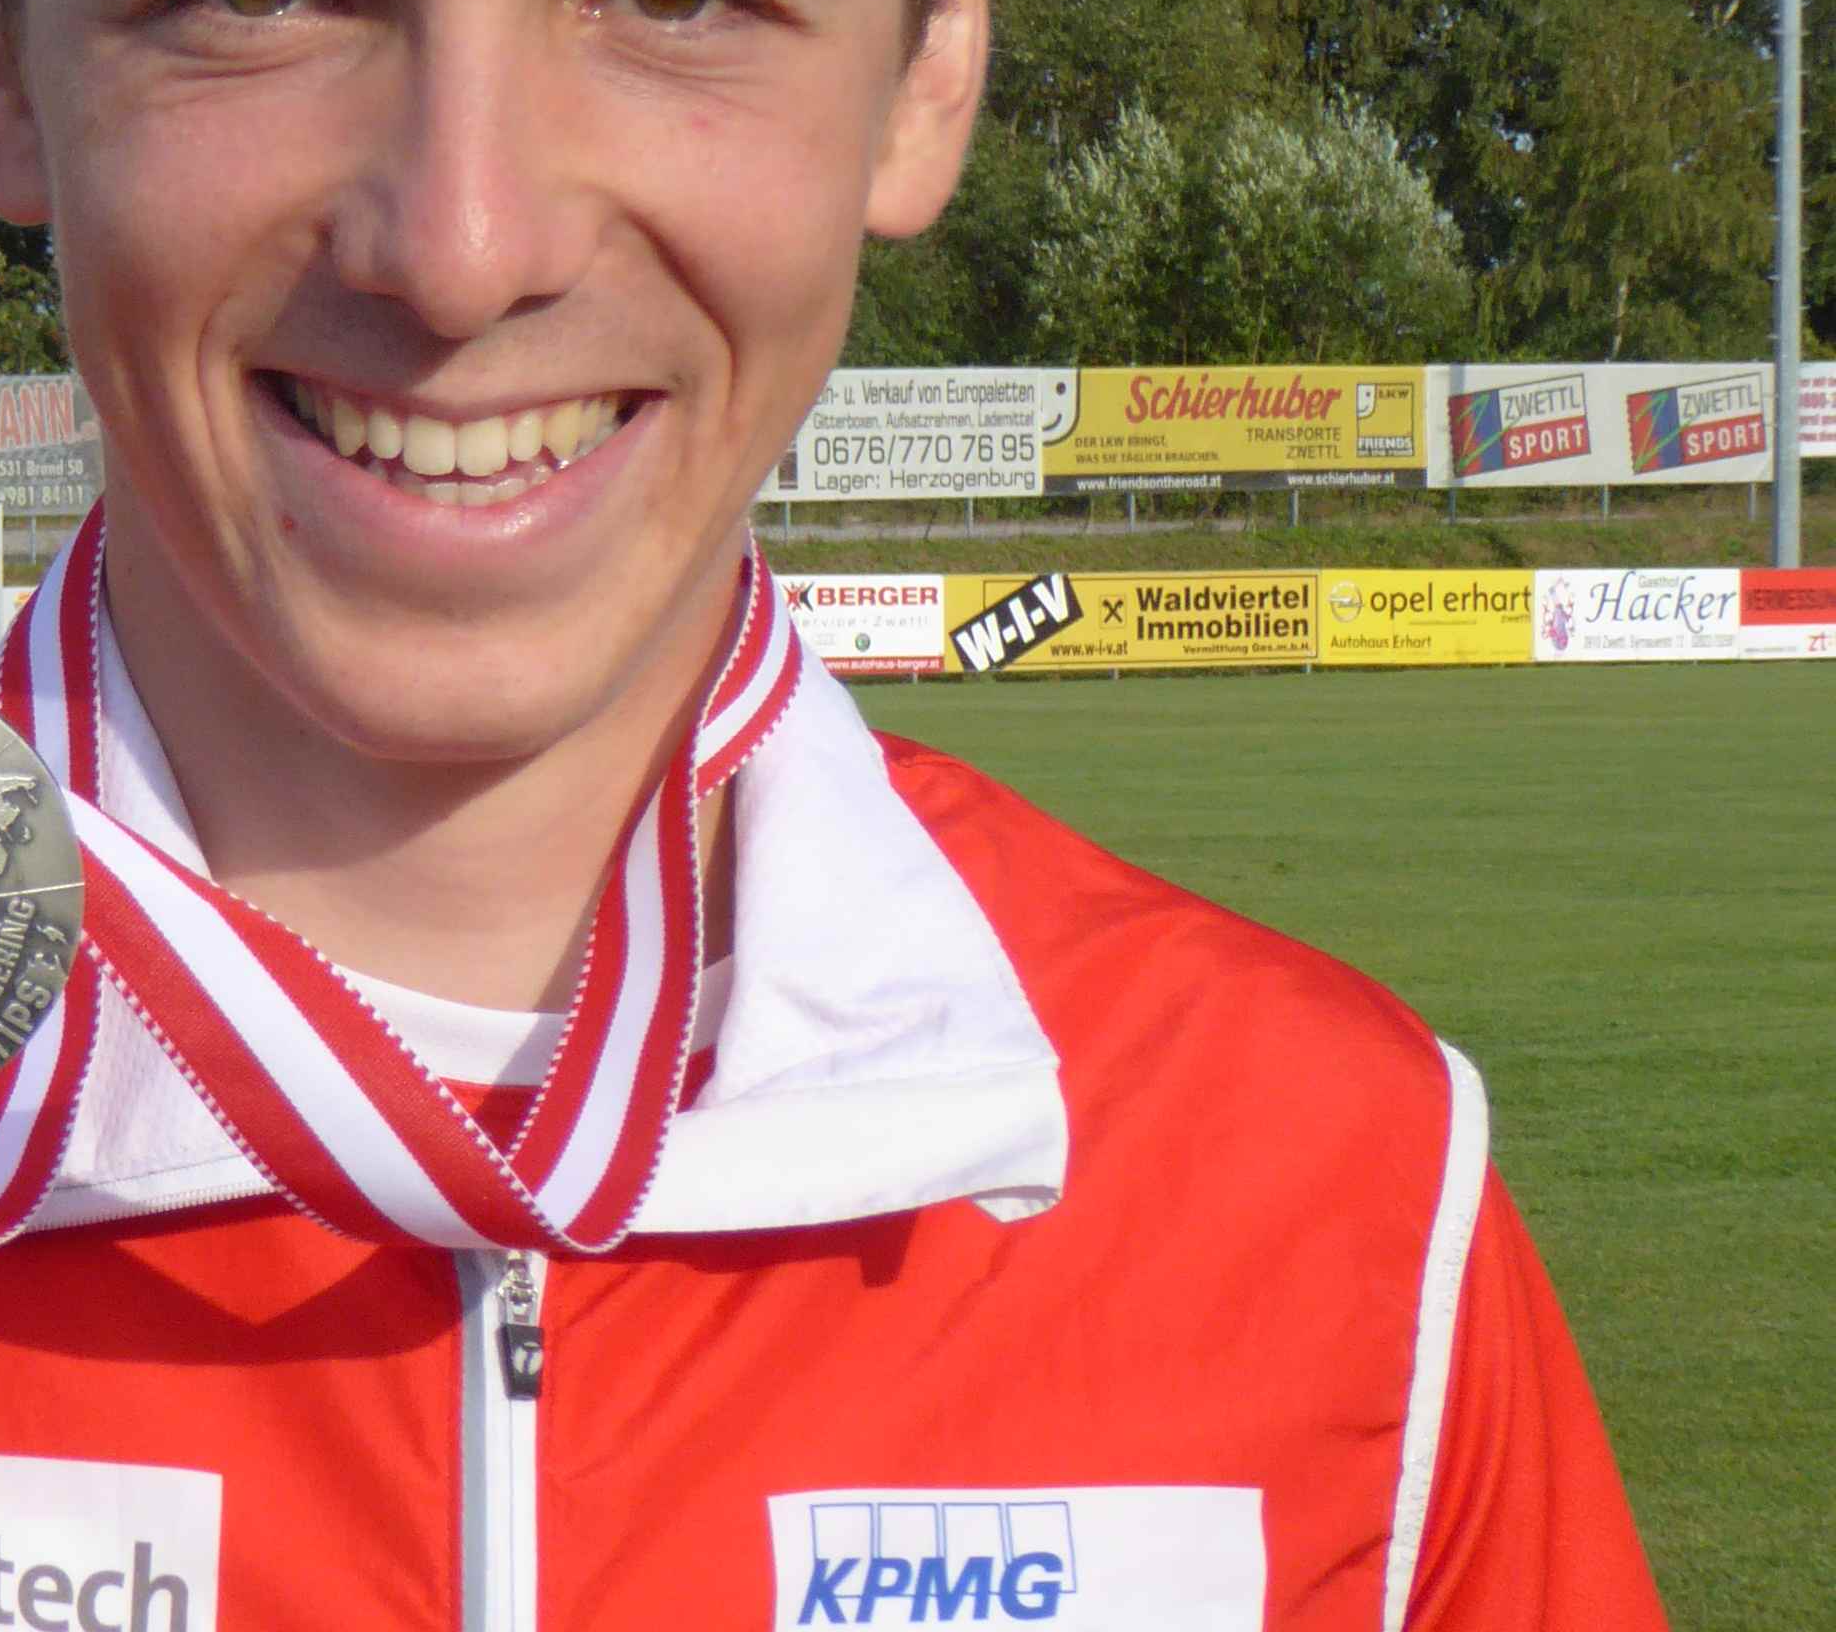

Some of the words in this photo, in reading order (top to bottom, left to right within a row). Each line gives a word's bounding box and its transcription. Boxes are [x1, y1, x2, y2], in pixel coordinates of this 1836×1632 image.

[862, 379, 914, 405] Verkauf
[918, 387, 941, 405] von
[947, 378, 1034, 409] Europaletten
[1125, 373, 1343, 424] Schierhuber
[1503, 386, 1581, 420] ZWETTL
[1681, 384, 1759, 418] ZWETTL
[979, 411, 1035, 428] Lademittel
[1075, 436, 1096, 448] DER
[1246, 427, 1341, 443] TRANSPORTE
[1358, 437, 1413, 449] FRIENDS
[1509, 423, 1584, 459] SPORT
[1686, 422, 1761, 456] SPORT
[814, 434, 952, 465] 0676/770
[961, 434, 993, 463] 76
[1002, 434, 1035, 462] 95
[1076, 454, 1099, 464] WAS
[1285, 445, 1342, 460] ZWETTL
[26, 459, 63, 477] Brand
[68, 459, 84, 476] 50
[814, 470, 881, 493] Lager:
[890, 468, 1035, 491] Herzogenburg
[817, 586, 938, 606] BERGER
[1136, 583, 1310, 612] Waldviertel
[1370, 582, 1433, 620] opel
[1443, 582, 1532, 613] erhart
[1586, 571, 1737, 634] Hacker
[956, 573, 1070, 672] W-I-V
[1137, 613, 1310, 641] Immobilien
[1051, 639, 1129, 657] www.w-i-v.at
[1331, 635, 1389, 649] Autohaus
[1393, 635, 1431, 648] Erhart
[796, 1551, 1066, 1625] KPMG
